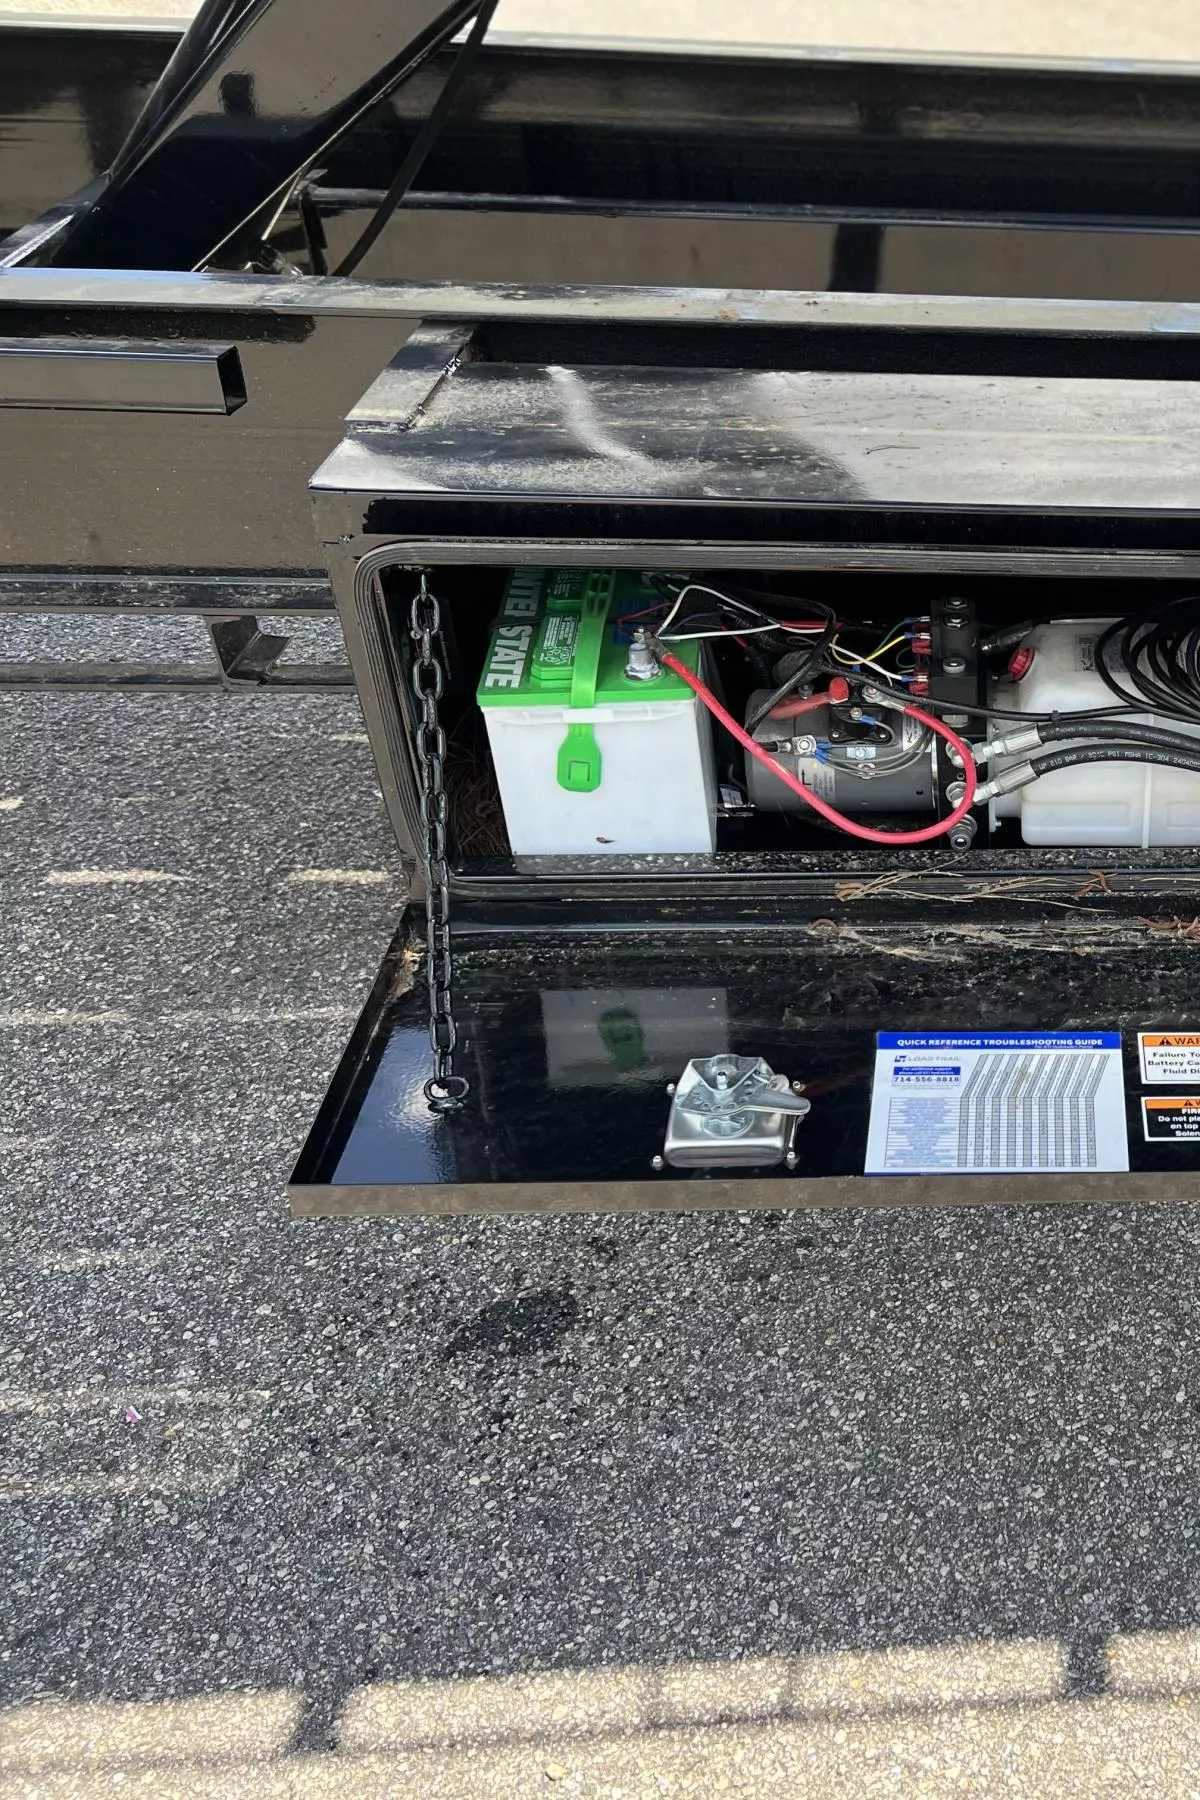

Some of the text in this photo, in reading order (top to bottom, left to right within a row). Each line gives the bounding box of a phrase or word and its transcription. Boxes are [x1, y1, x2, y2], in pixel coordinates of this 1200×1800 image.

[1049, 757, 1063, 767] 210
[1075, 1038, 1103, 1046] GUIDE
[1184, 1123, 1198, 1131] top
